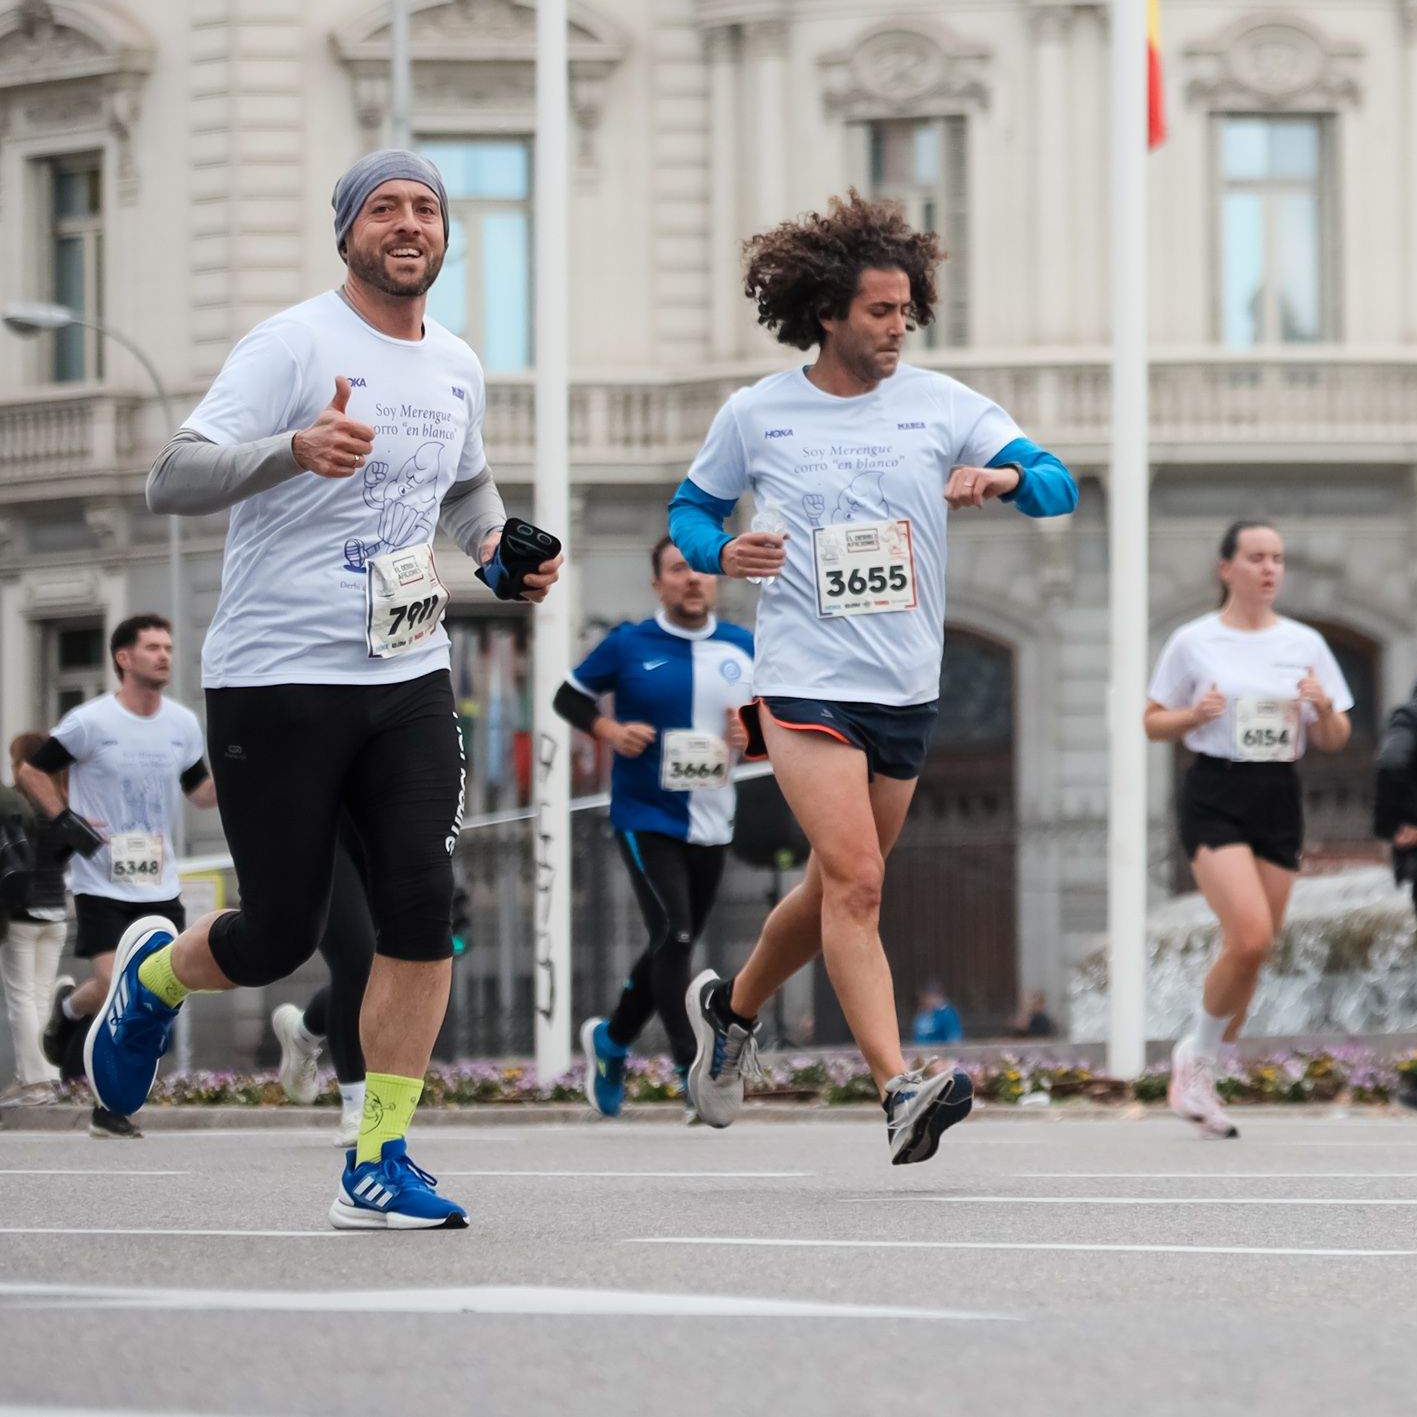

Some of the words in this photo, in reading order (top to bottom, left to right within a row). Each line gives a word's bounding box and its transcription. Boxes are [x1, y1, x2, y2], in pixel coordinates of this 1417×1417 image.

[375, 403, 397, 420] Soy
[400, 404, 452, 424] Merengue
[374, 425, 399, 436] orro
[765, 429, 793, 439] HOKA
[802, 445, 825, 460] Soy
[831, 443, 894, 457] Merengue
[794, 462, 828, 474] corro
[826, 564, 908, 597] 3655
[388, 594, 439, 636] 7911
